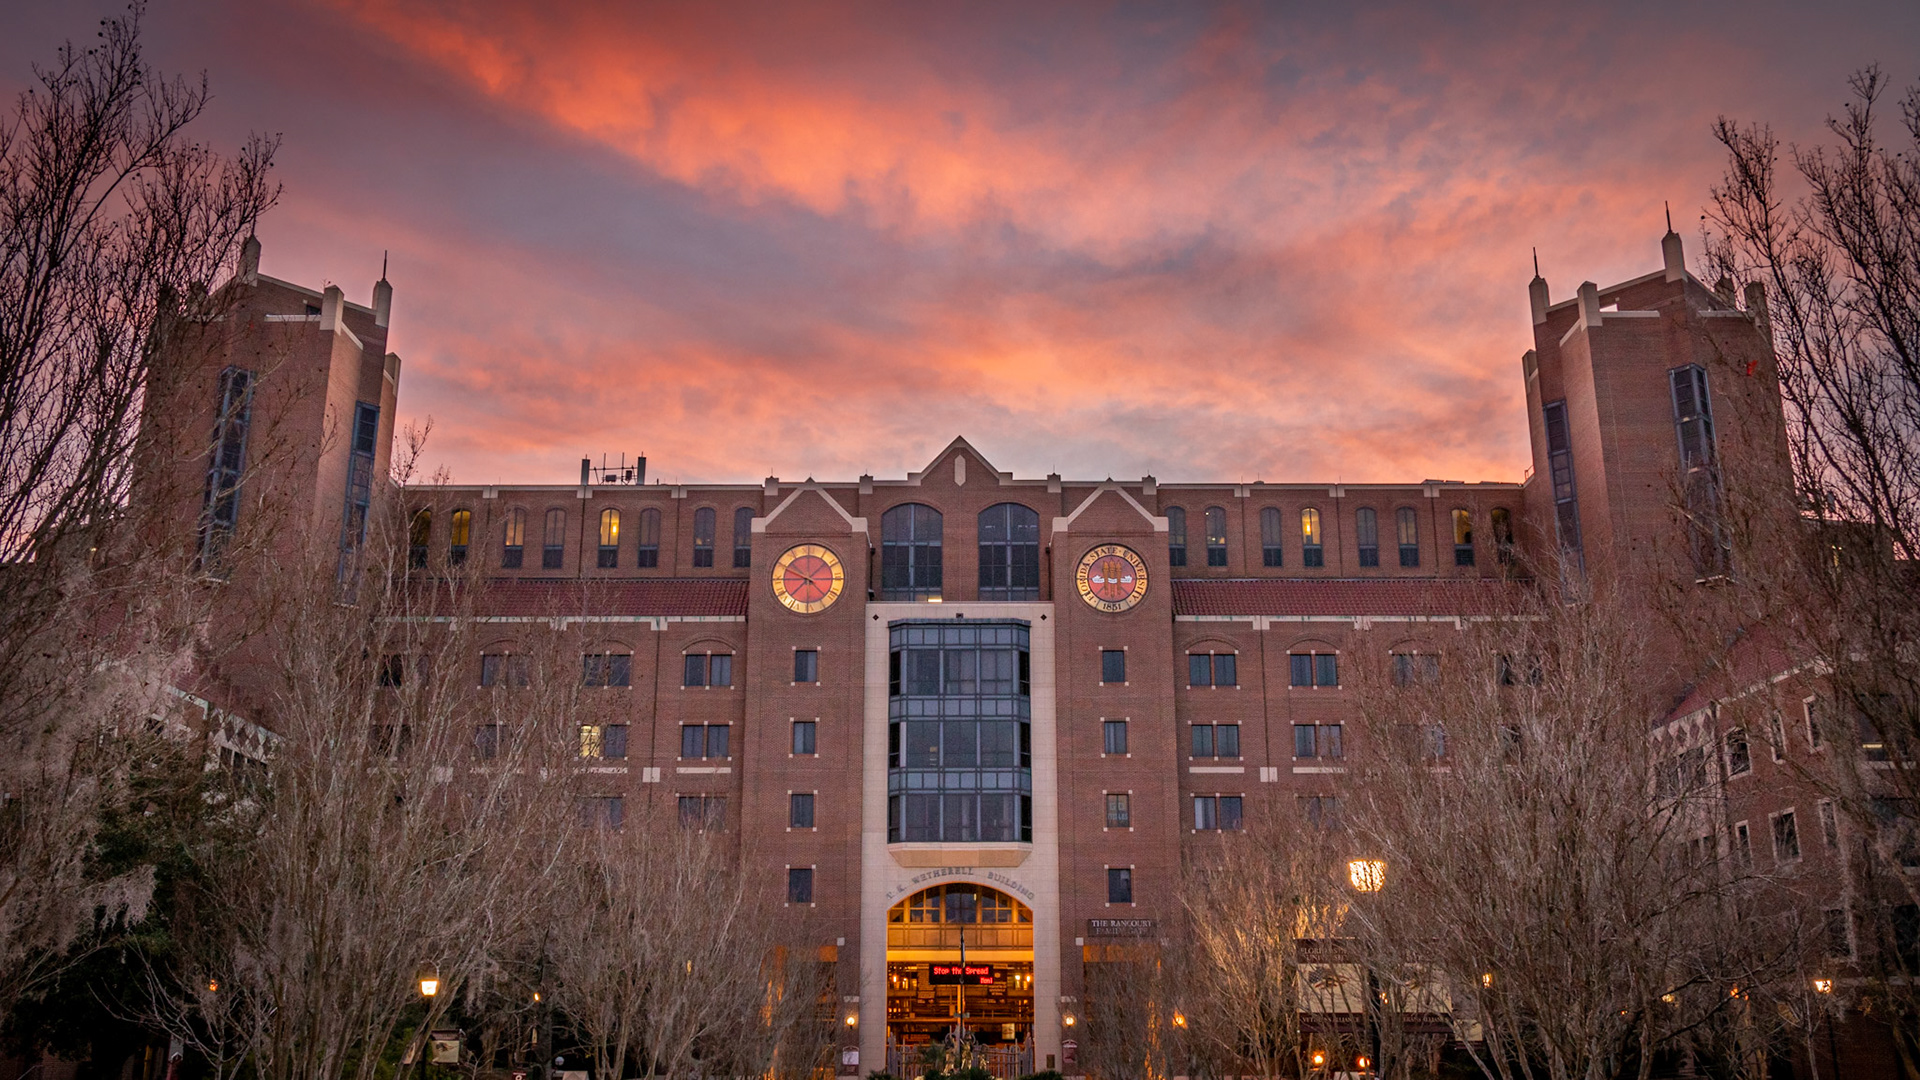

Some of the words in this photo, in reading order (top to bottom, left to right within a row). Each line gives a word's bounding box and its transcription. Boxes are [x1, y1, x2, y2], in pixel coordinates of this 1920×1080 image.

[1080, 562, 1094, 601] FLORIDA
[1090, 547, 1118, 561] STATE
[1123, 550, 1145, 601] UNIVERSITY
[1103, 603, 1121, 611] 1851
[911, 867, 974, 883] WETHERELL
[987, 871, 1035, 900] BUILDING
[933, 966, 950, 975] Stop
[965, 966, 989, 975] Spread
